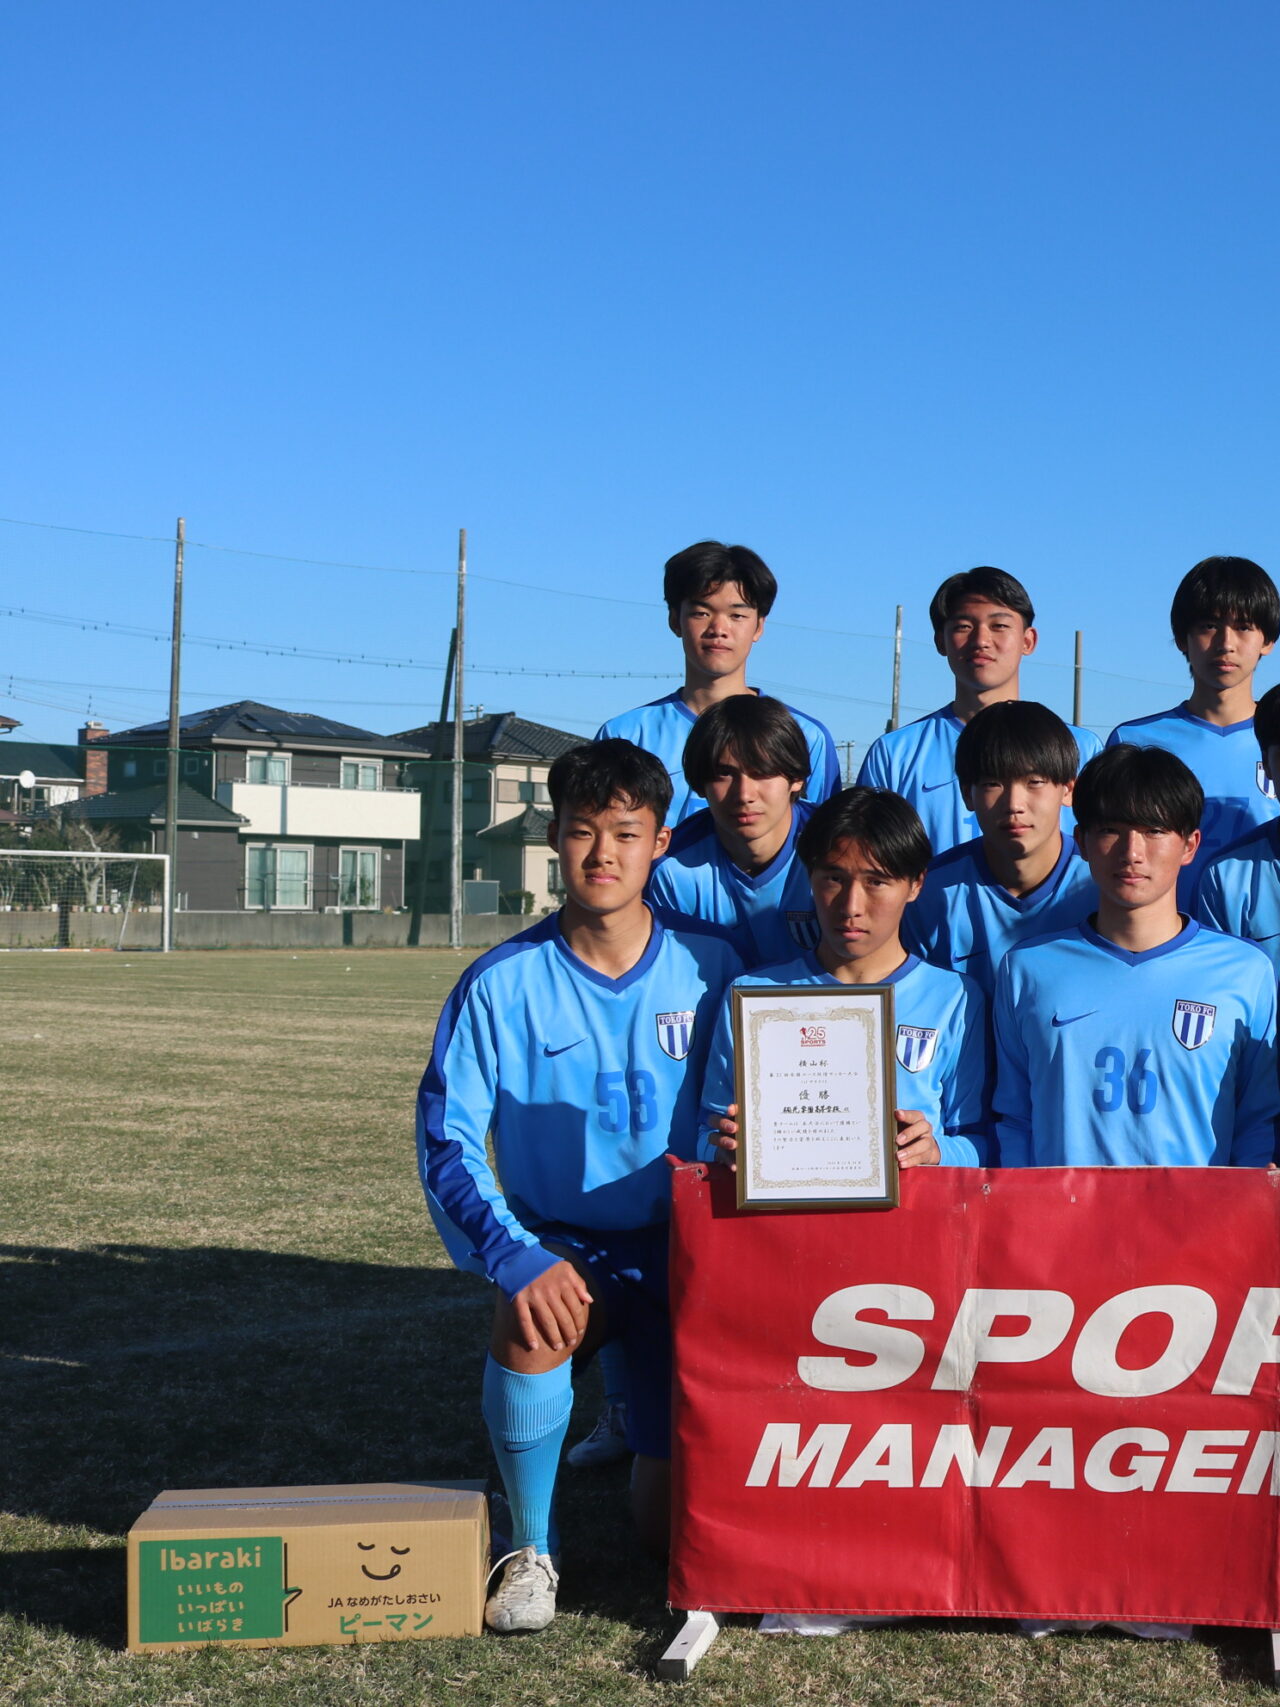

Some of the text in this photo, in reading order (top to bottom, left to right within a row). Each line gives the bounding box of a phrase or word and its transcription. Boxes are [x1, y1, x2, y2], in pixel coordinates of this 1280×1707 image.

[1179, 1003, 1214, 1016] TOKO FC
[659, 1014, 693, 1025] TOKO FC
[901, 1028, 936, 1039] TOKO FC
[1093, 1046, 1158, 1114] 36
[597, 1069, 658, 1132] 53
[160, 1546, 262, 1571] Ibaraki
[177, 1581, 244, 1596] いいもの
[177, 1600, 245, 1615] いっぱい
[328, 1593, 441, 1608] JA なめがたしおさい
[177, 1618, 245, 1633] いばらき
[339, 1613, 433, 1636] ピーマン
